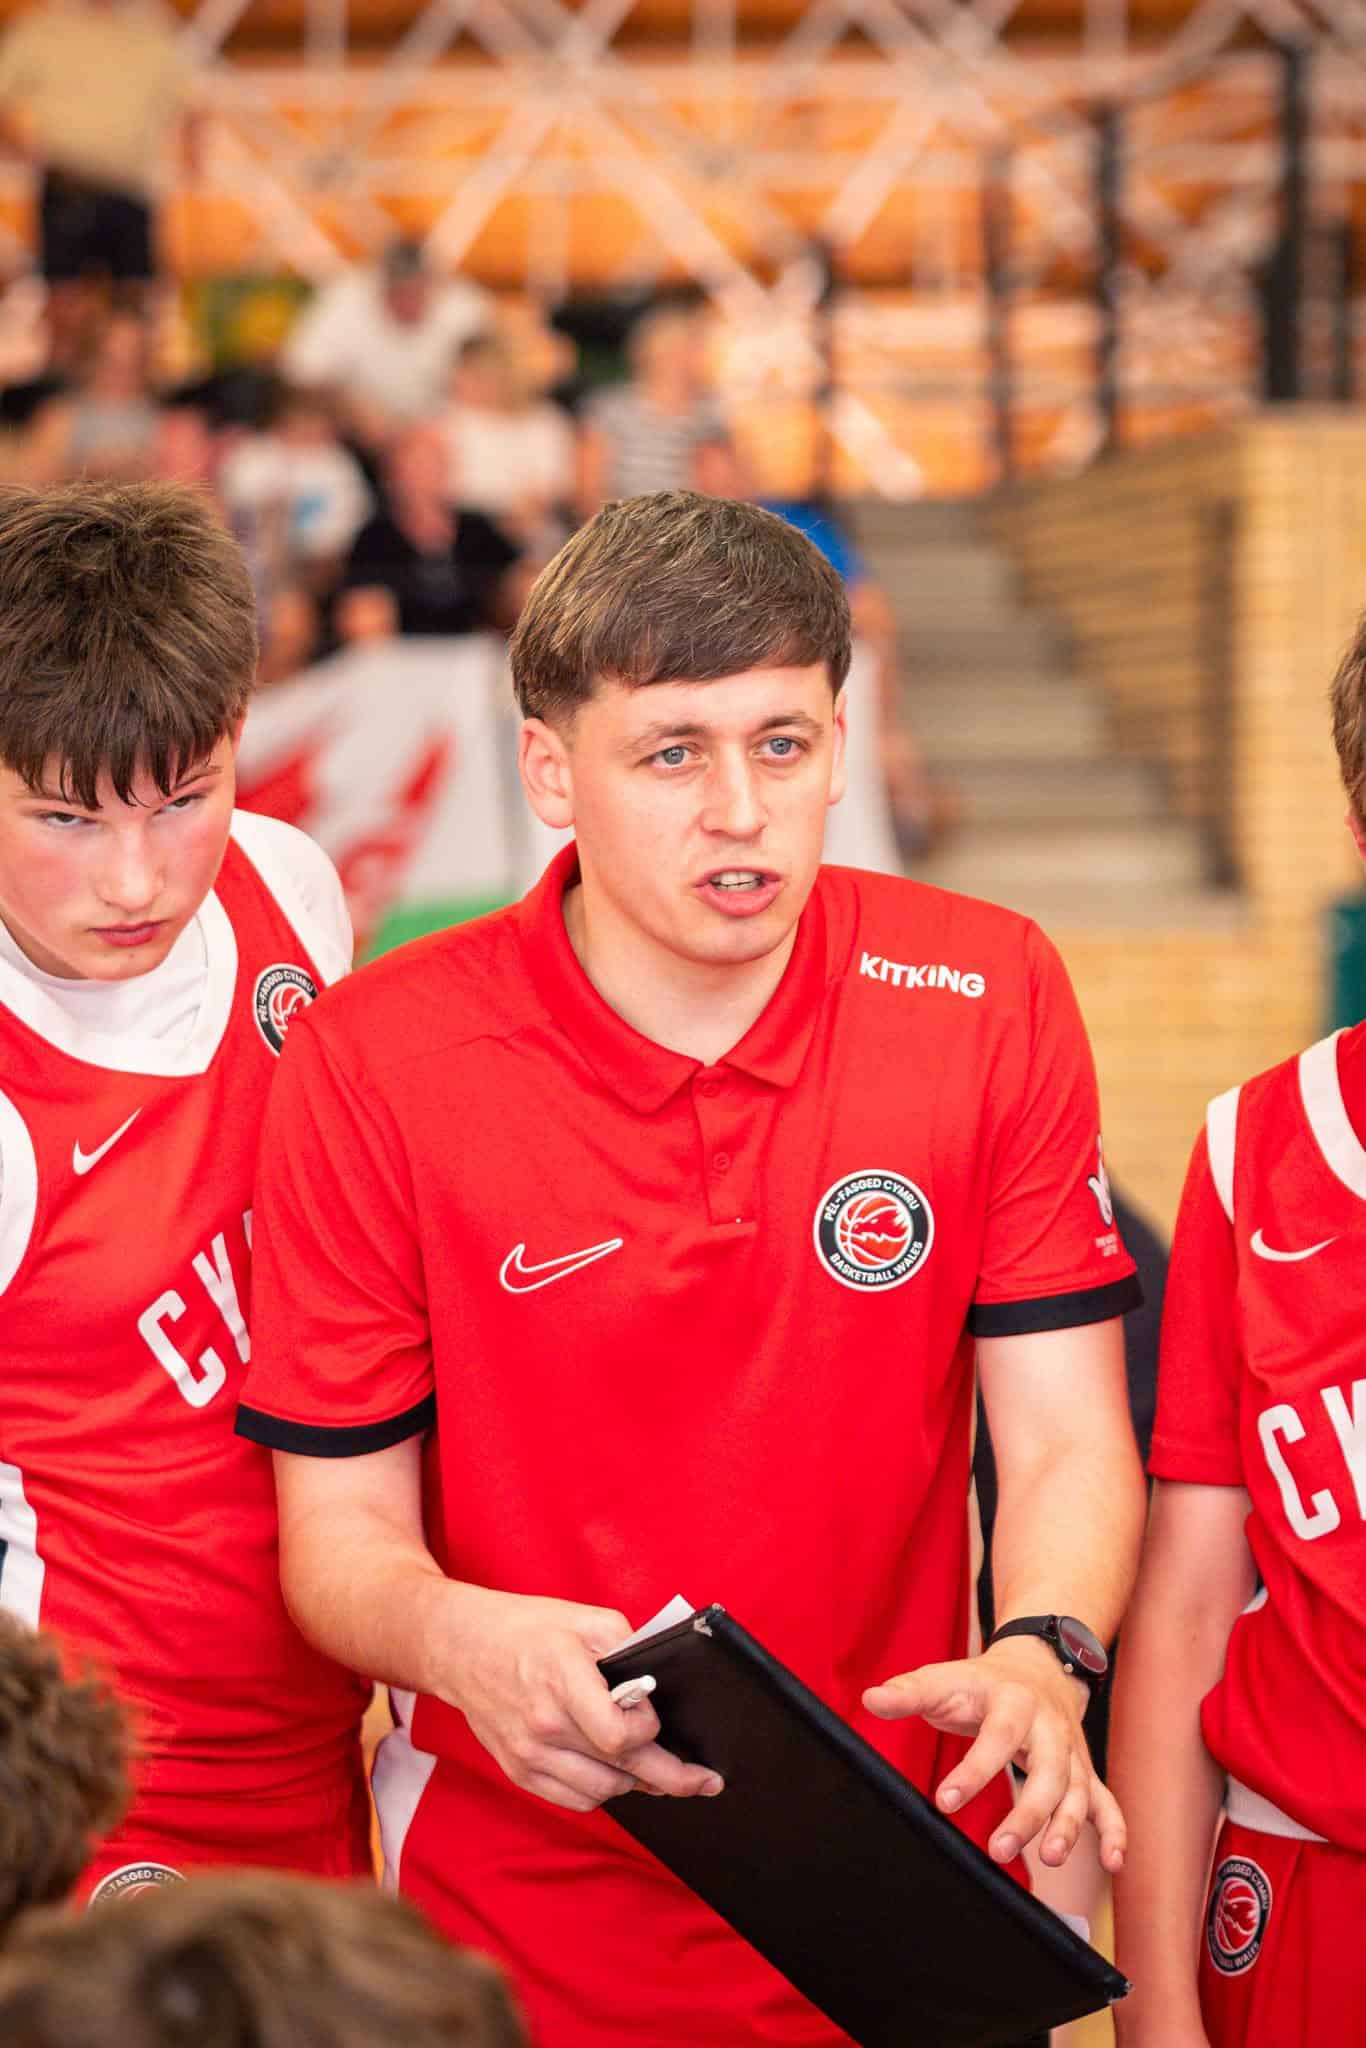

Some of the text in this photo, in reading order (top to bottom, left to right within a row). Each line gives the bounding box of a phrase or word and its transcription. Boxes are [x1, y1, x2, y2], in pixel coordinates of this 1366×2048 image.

[859, 951, 986, 998] KITKING
[883, 1180, 920, 1211] CYMRU
[829, 1240, 923, 1284] BASKETBALL WALES
